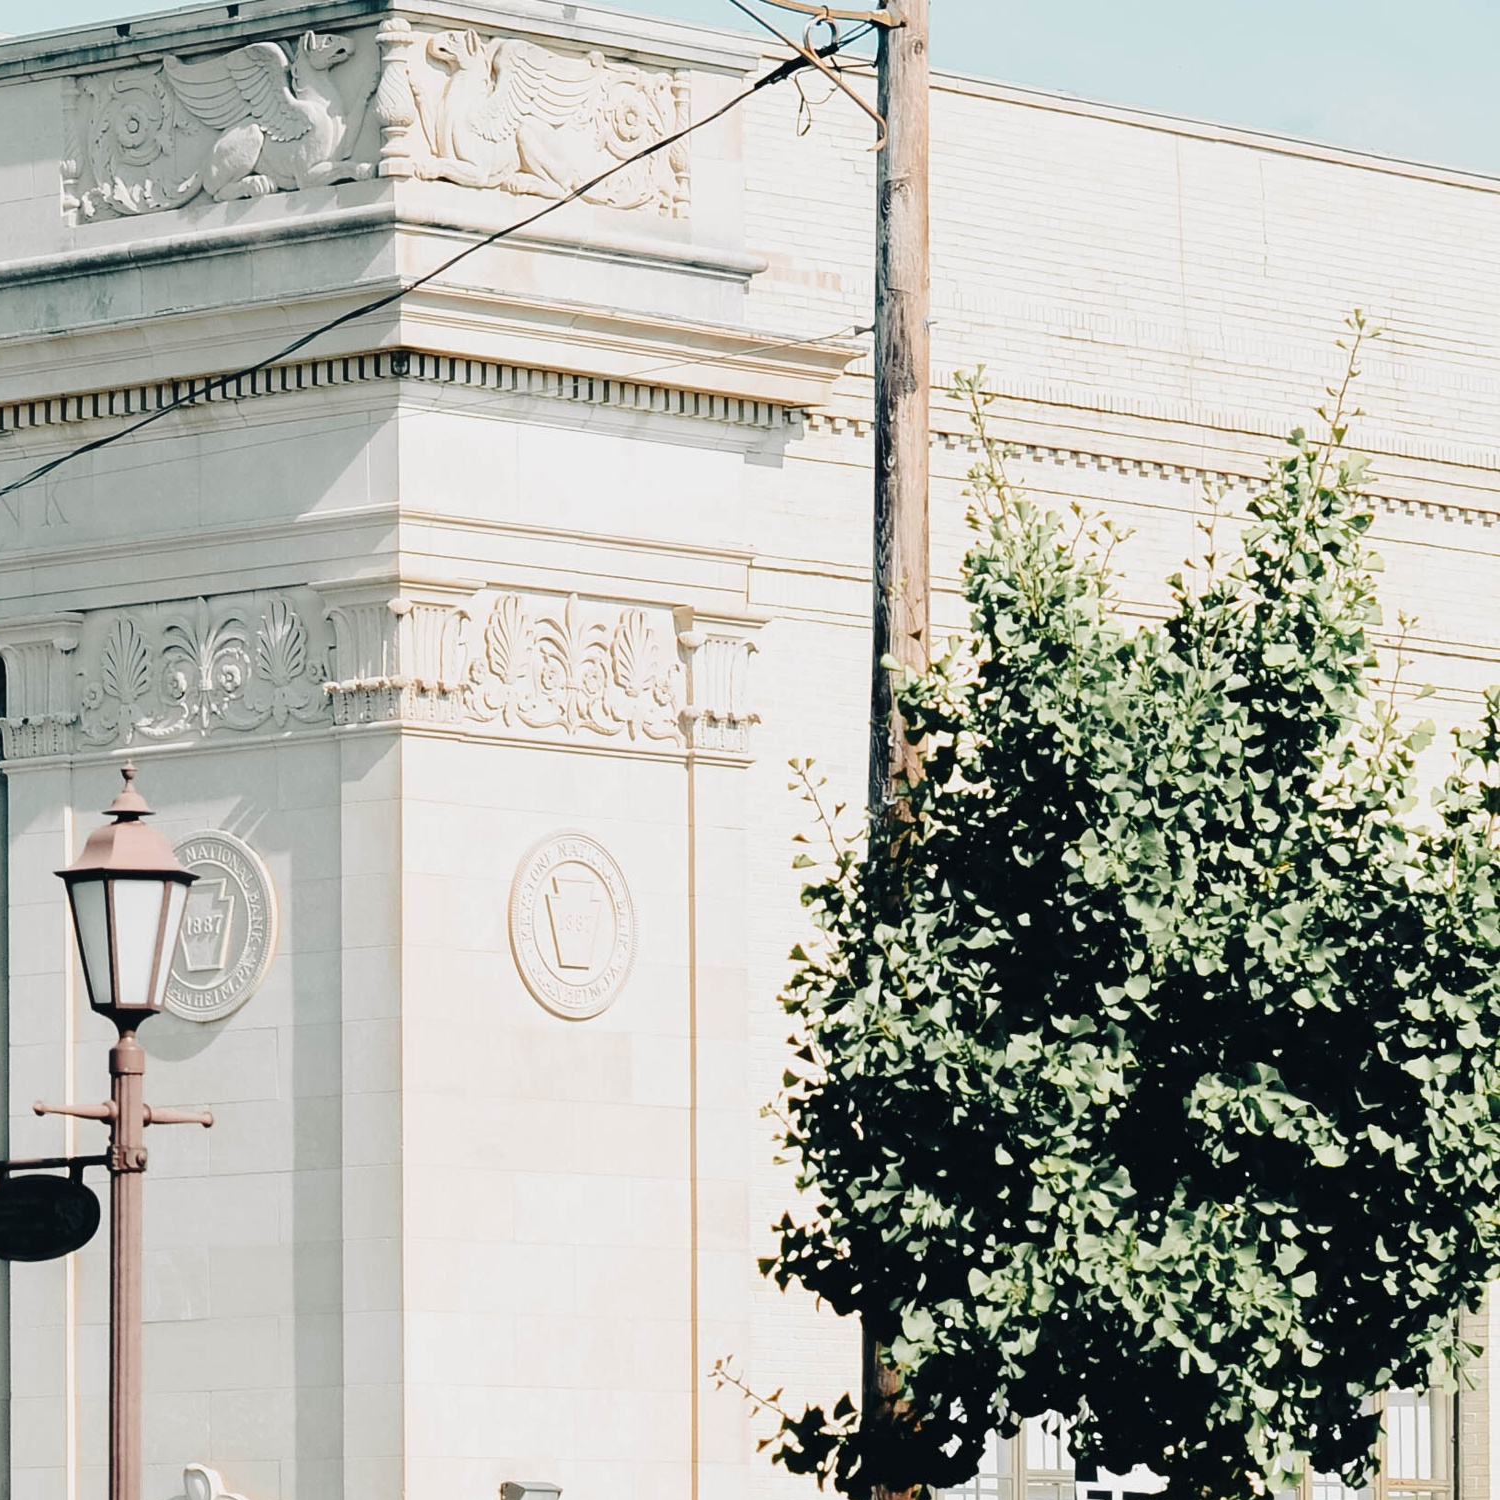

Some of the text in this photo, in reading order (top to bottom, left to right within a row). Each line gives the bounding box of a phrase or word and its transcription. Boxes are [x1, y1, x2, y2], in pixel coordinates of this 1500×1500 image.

[185, 845, 264, 945] NATIONAL BANK
[186, 914, 224, 935] 1887
